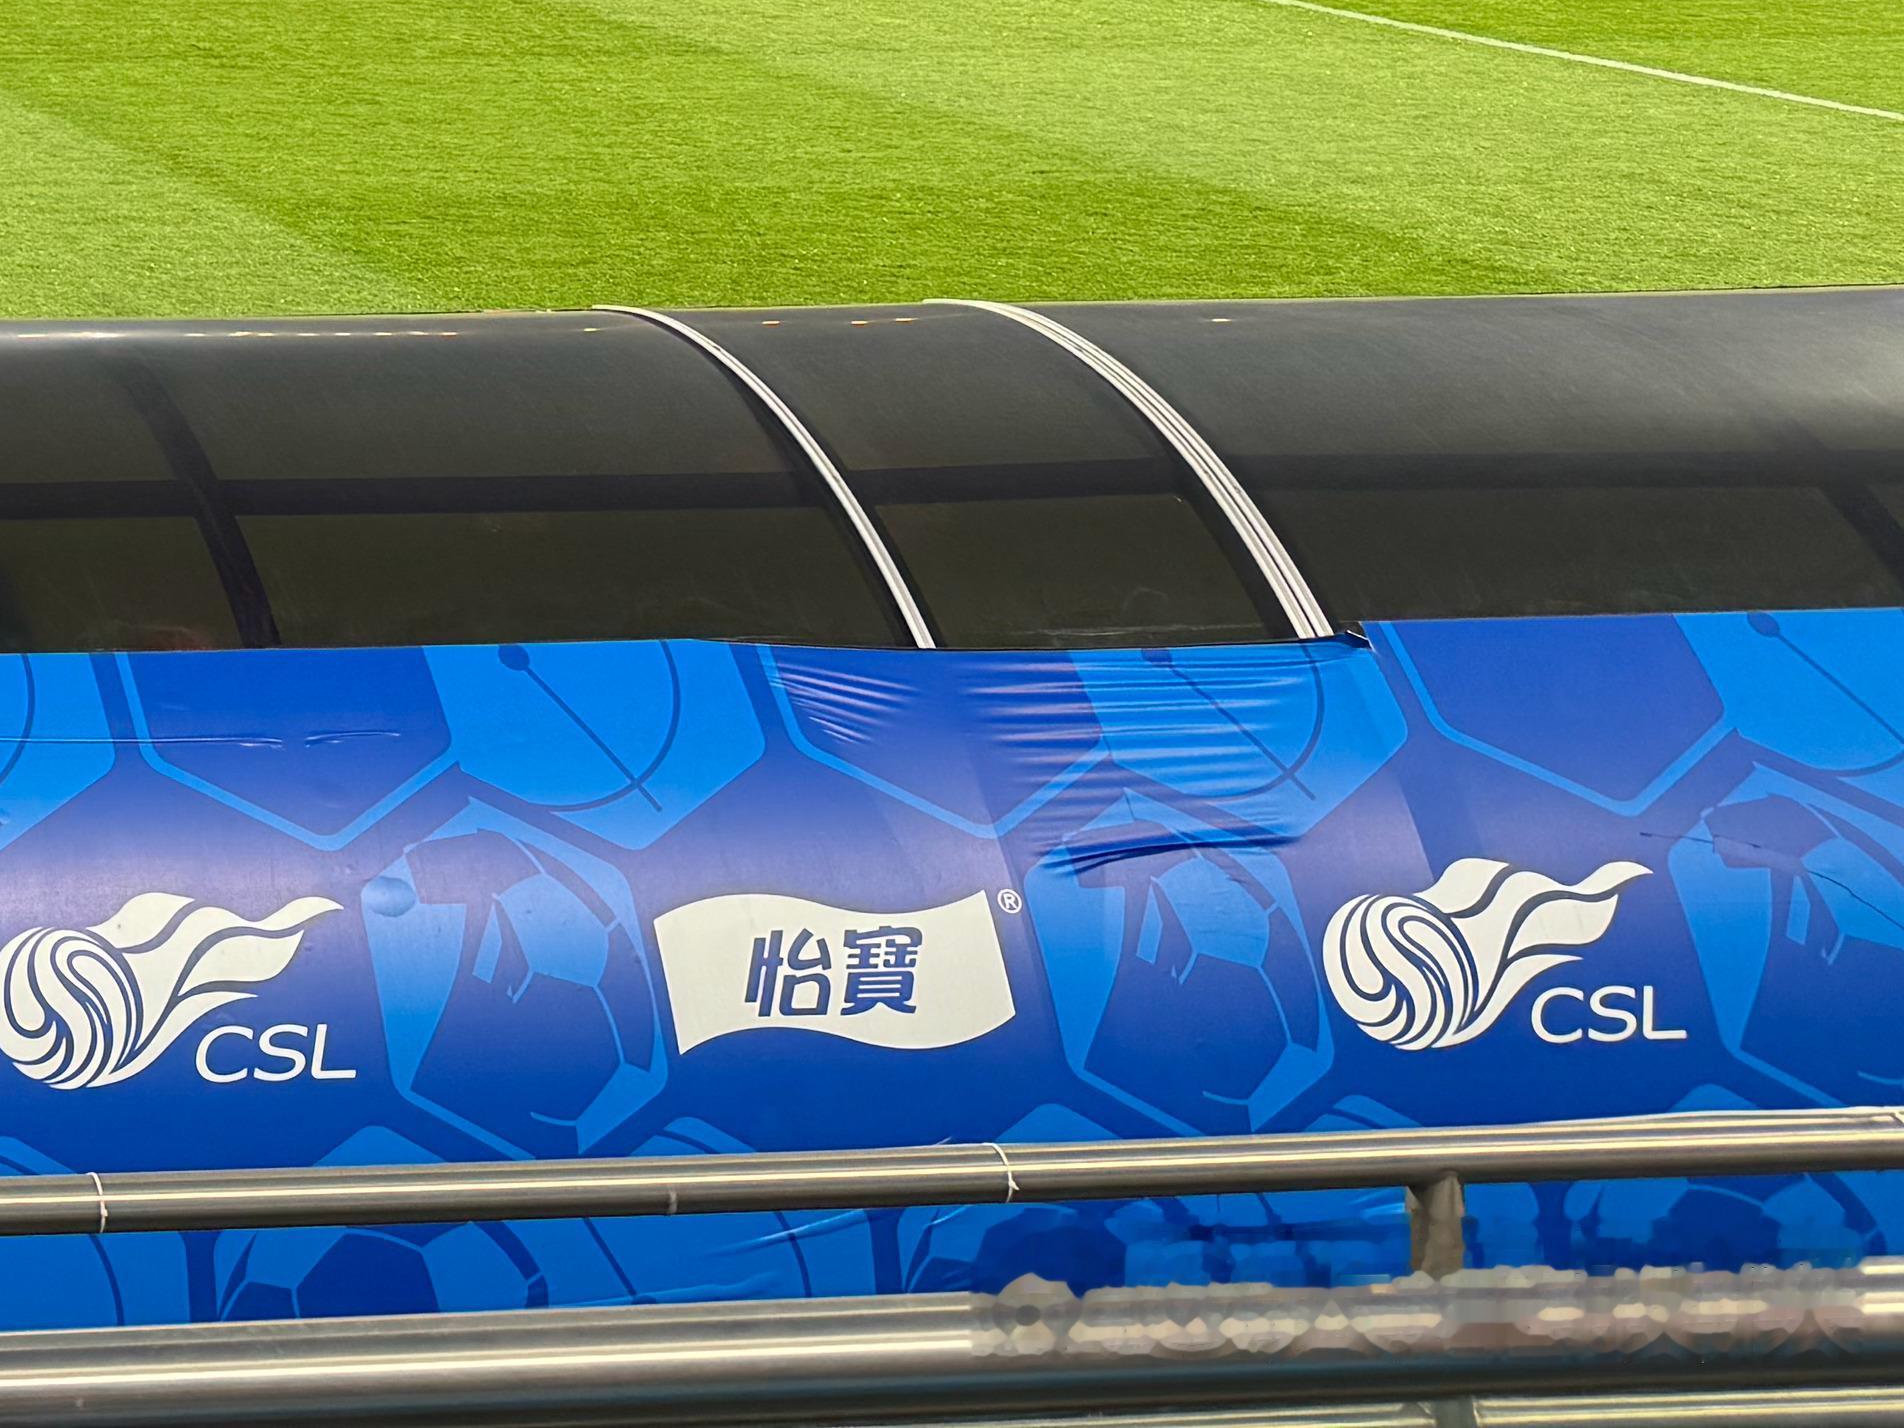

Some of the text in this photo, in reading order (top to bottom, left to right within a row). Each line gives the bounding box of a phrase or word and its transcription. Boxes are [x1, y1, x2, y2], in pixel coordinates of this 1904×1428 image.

[744, 926, 924, 1018] 怡寶
[1531, 985, 1688, 1045] CSL
[194, 1024, 358, 1084] CSL
